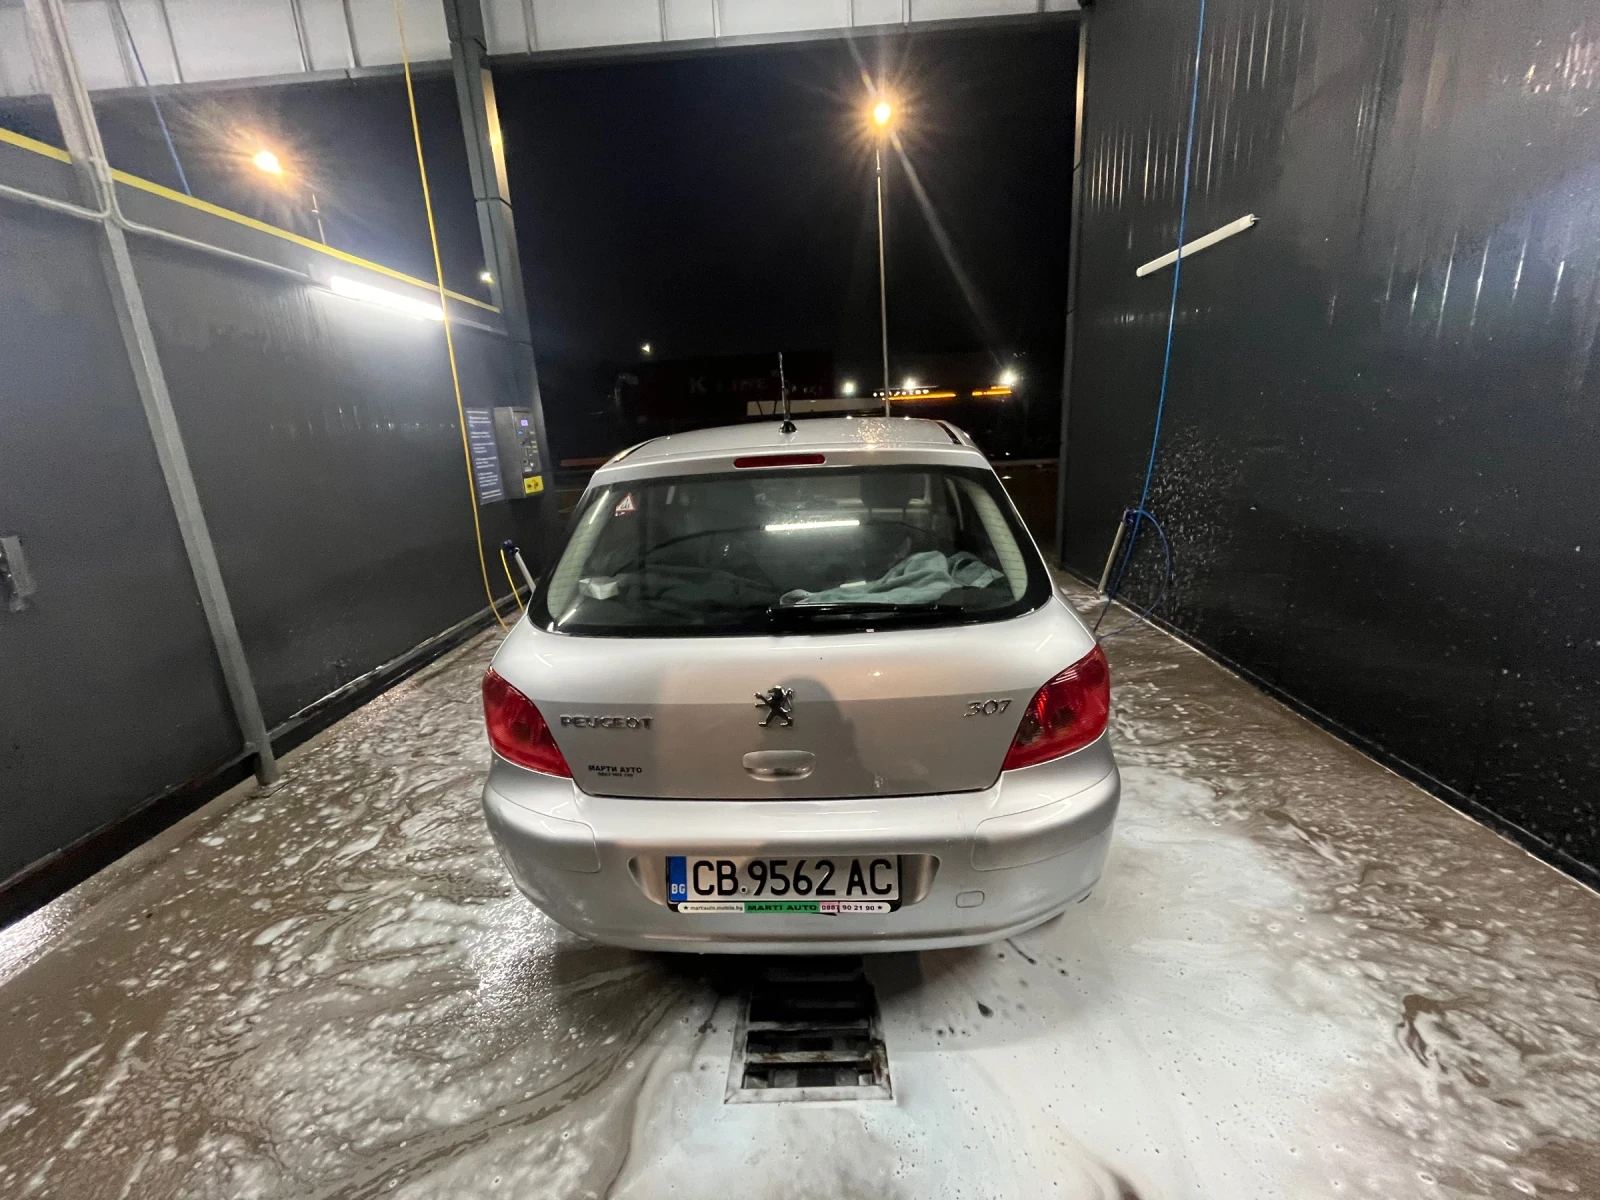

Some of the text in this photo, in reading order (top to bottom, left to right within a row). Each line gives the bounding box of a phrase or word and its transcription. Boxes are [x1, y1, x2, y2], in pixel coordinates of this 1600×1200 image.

[963, 698, 1013, 717] 307
[559, 714, 654, 729] PEUGEOT
[588, 765, 642, 774] МАРТИ АУТО
[747, 859, 836, 896] 9562
[846, 859, 892, 896] AC
[671, 883, 686, 895] BG
